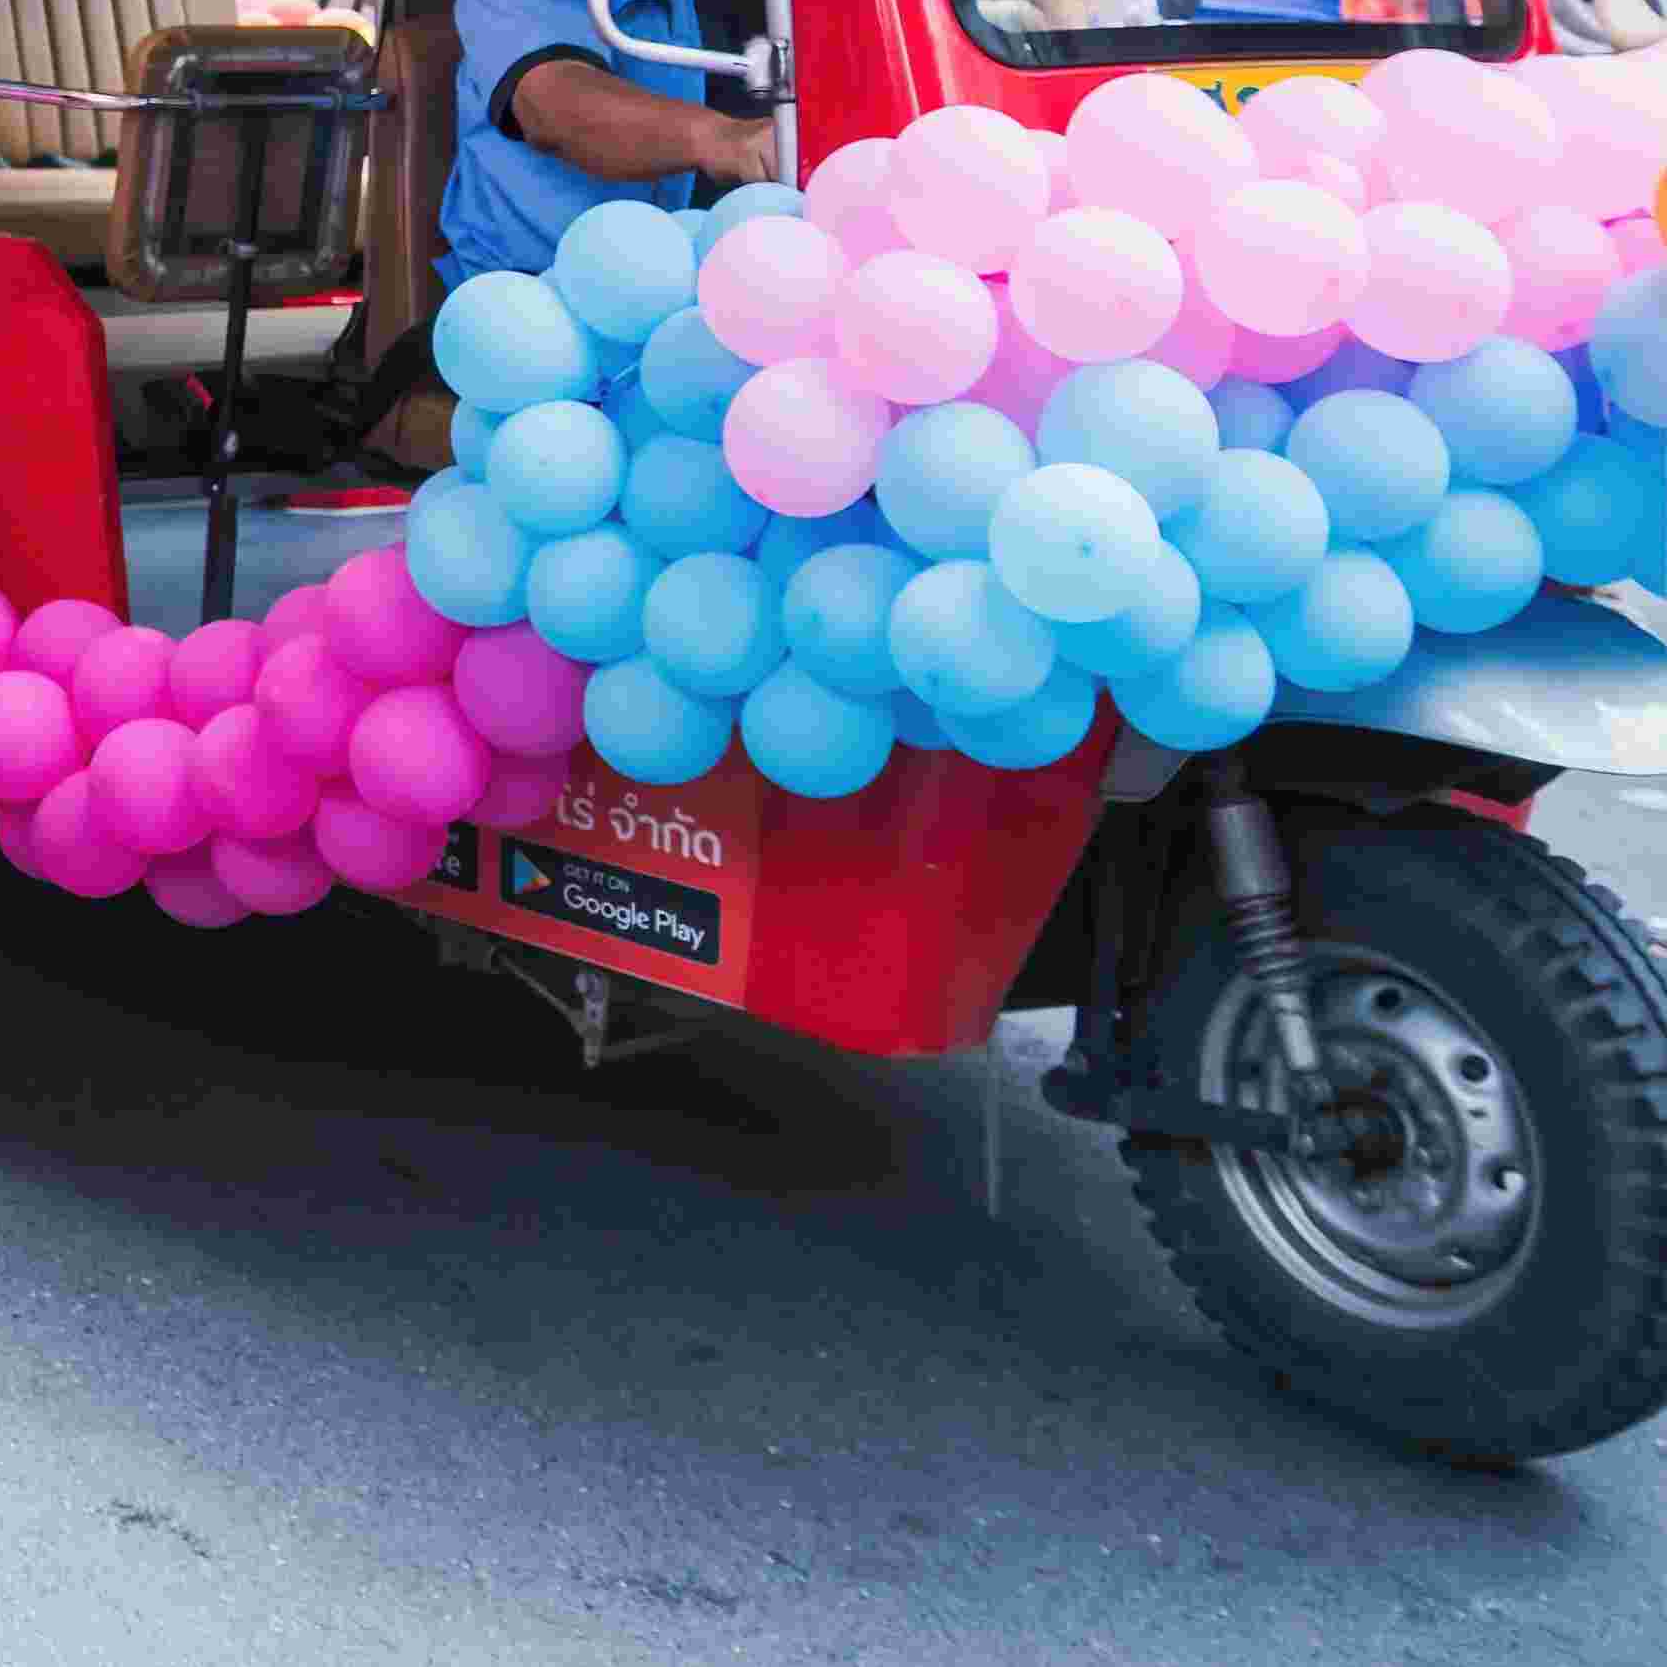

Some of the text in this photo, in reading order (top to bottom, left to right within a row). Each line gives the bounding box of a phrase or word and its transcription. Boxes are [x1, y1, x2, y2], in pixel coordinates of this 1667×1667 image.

[607, 791, 723, 868] จำกัด
[563, 883, 706, 951] Google Play
